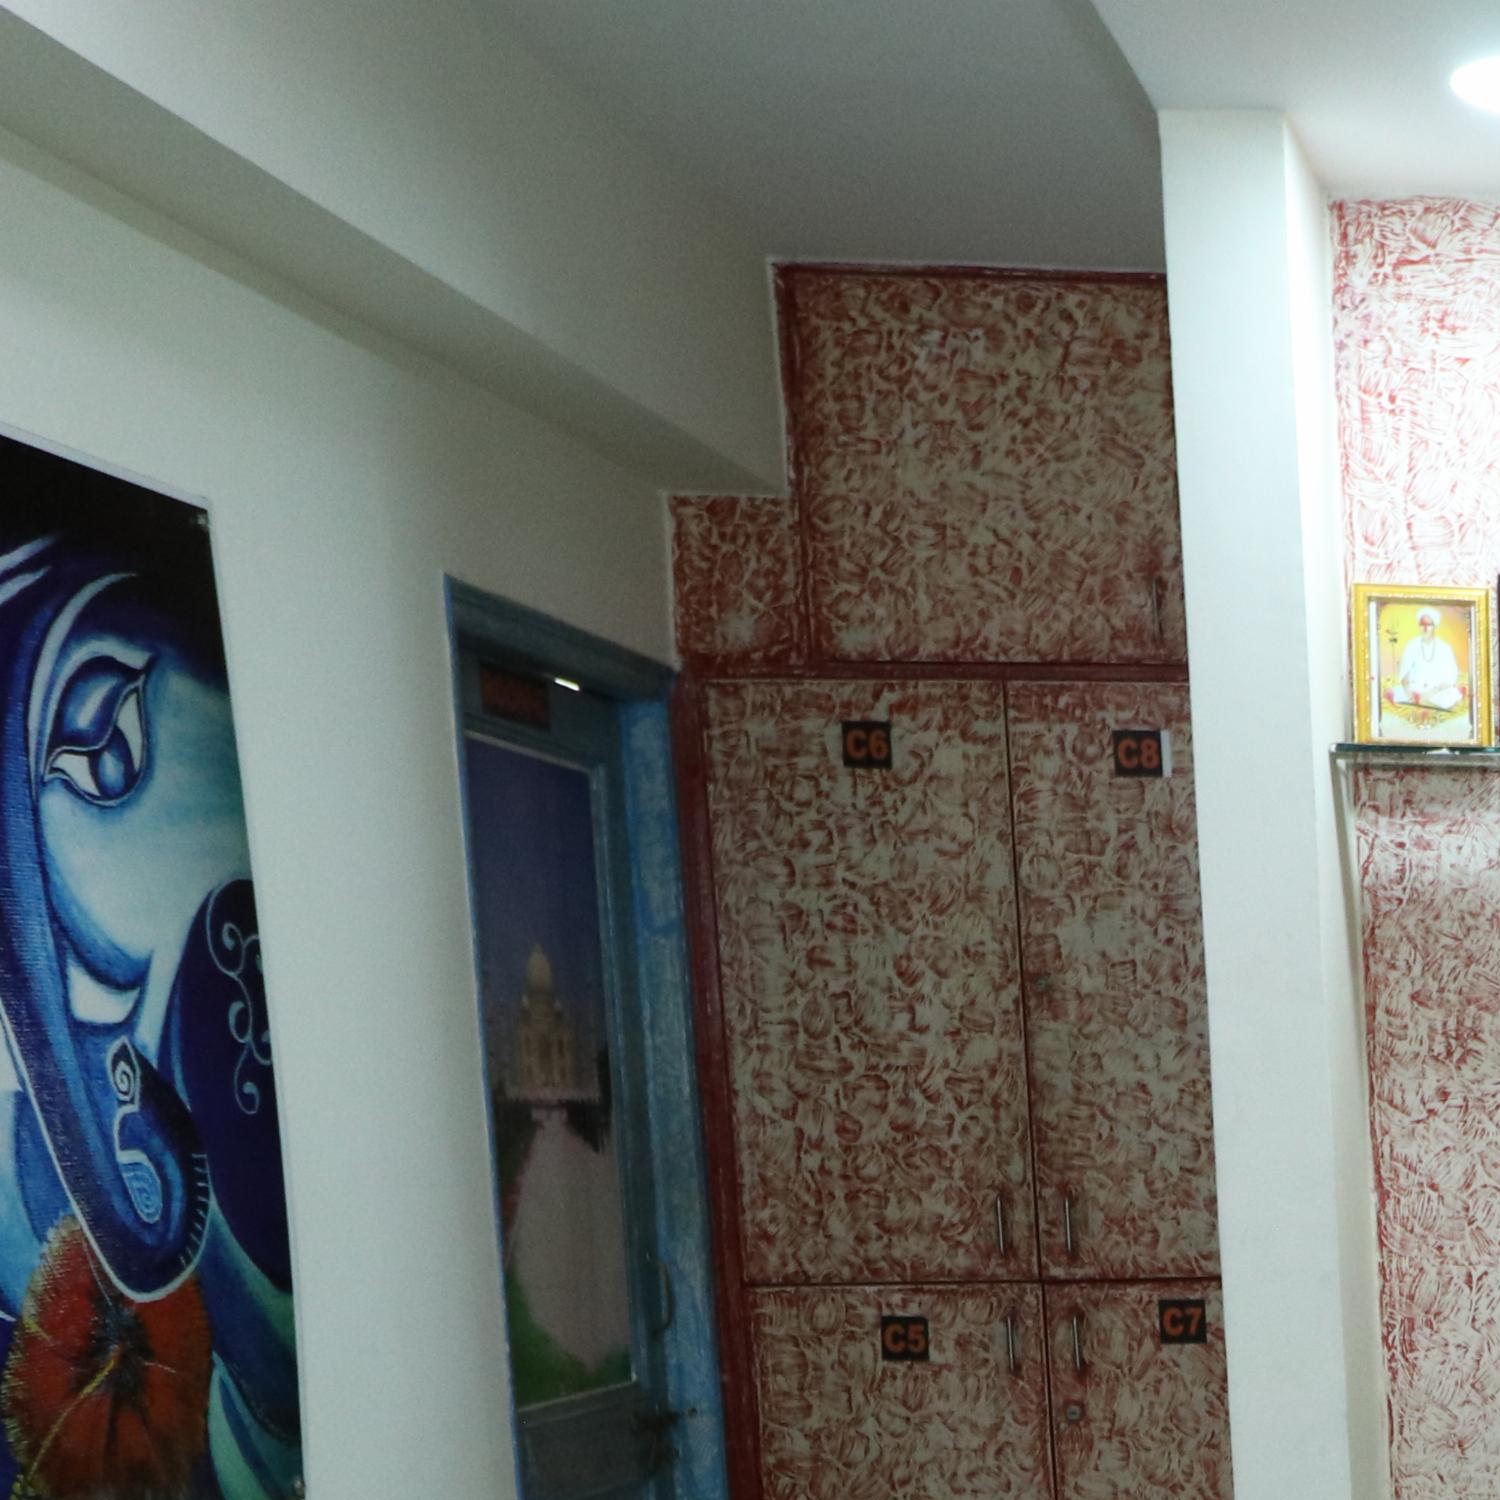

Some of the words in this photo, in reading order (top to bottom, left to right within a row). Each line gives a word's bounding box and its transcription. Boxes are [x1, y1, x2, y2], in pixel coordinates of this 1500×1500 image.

[847, 729, 888, 759] C6
[1118, 738, 1159, 769] C8
[1162, 1306, 1202, 1336] C7
[884, 1323, 925, 1353] C5
